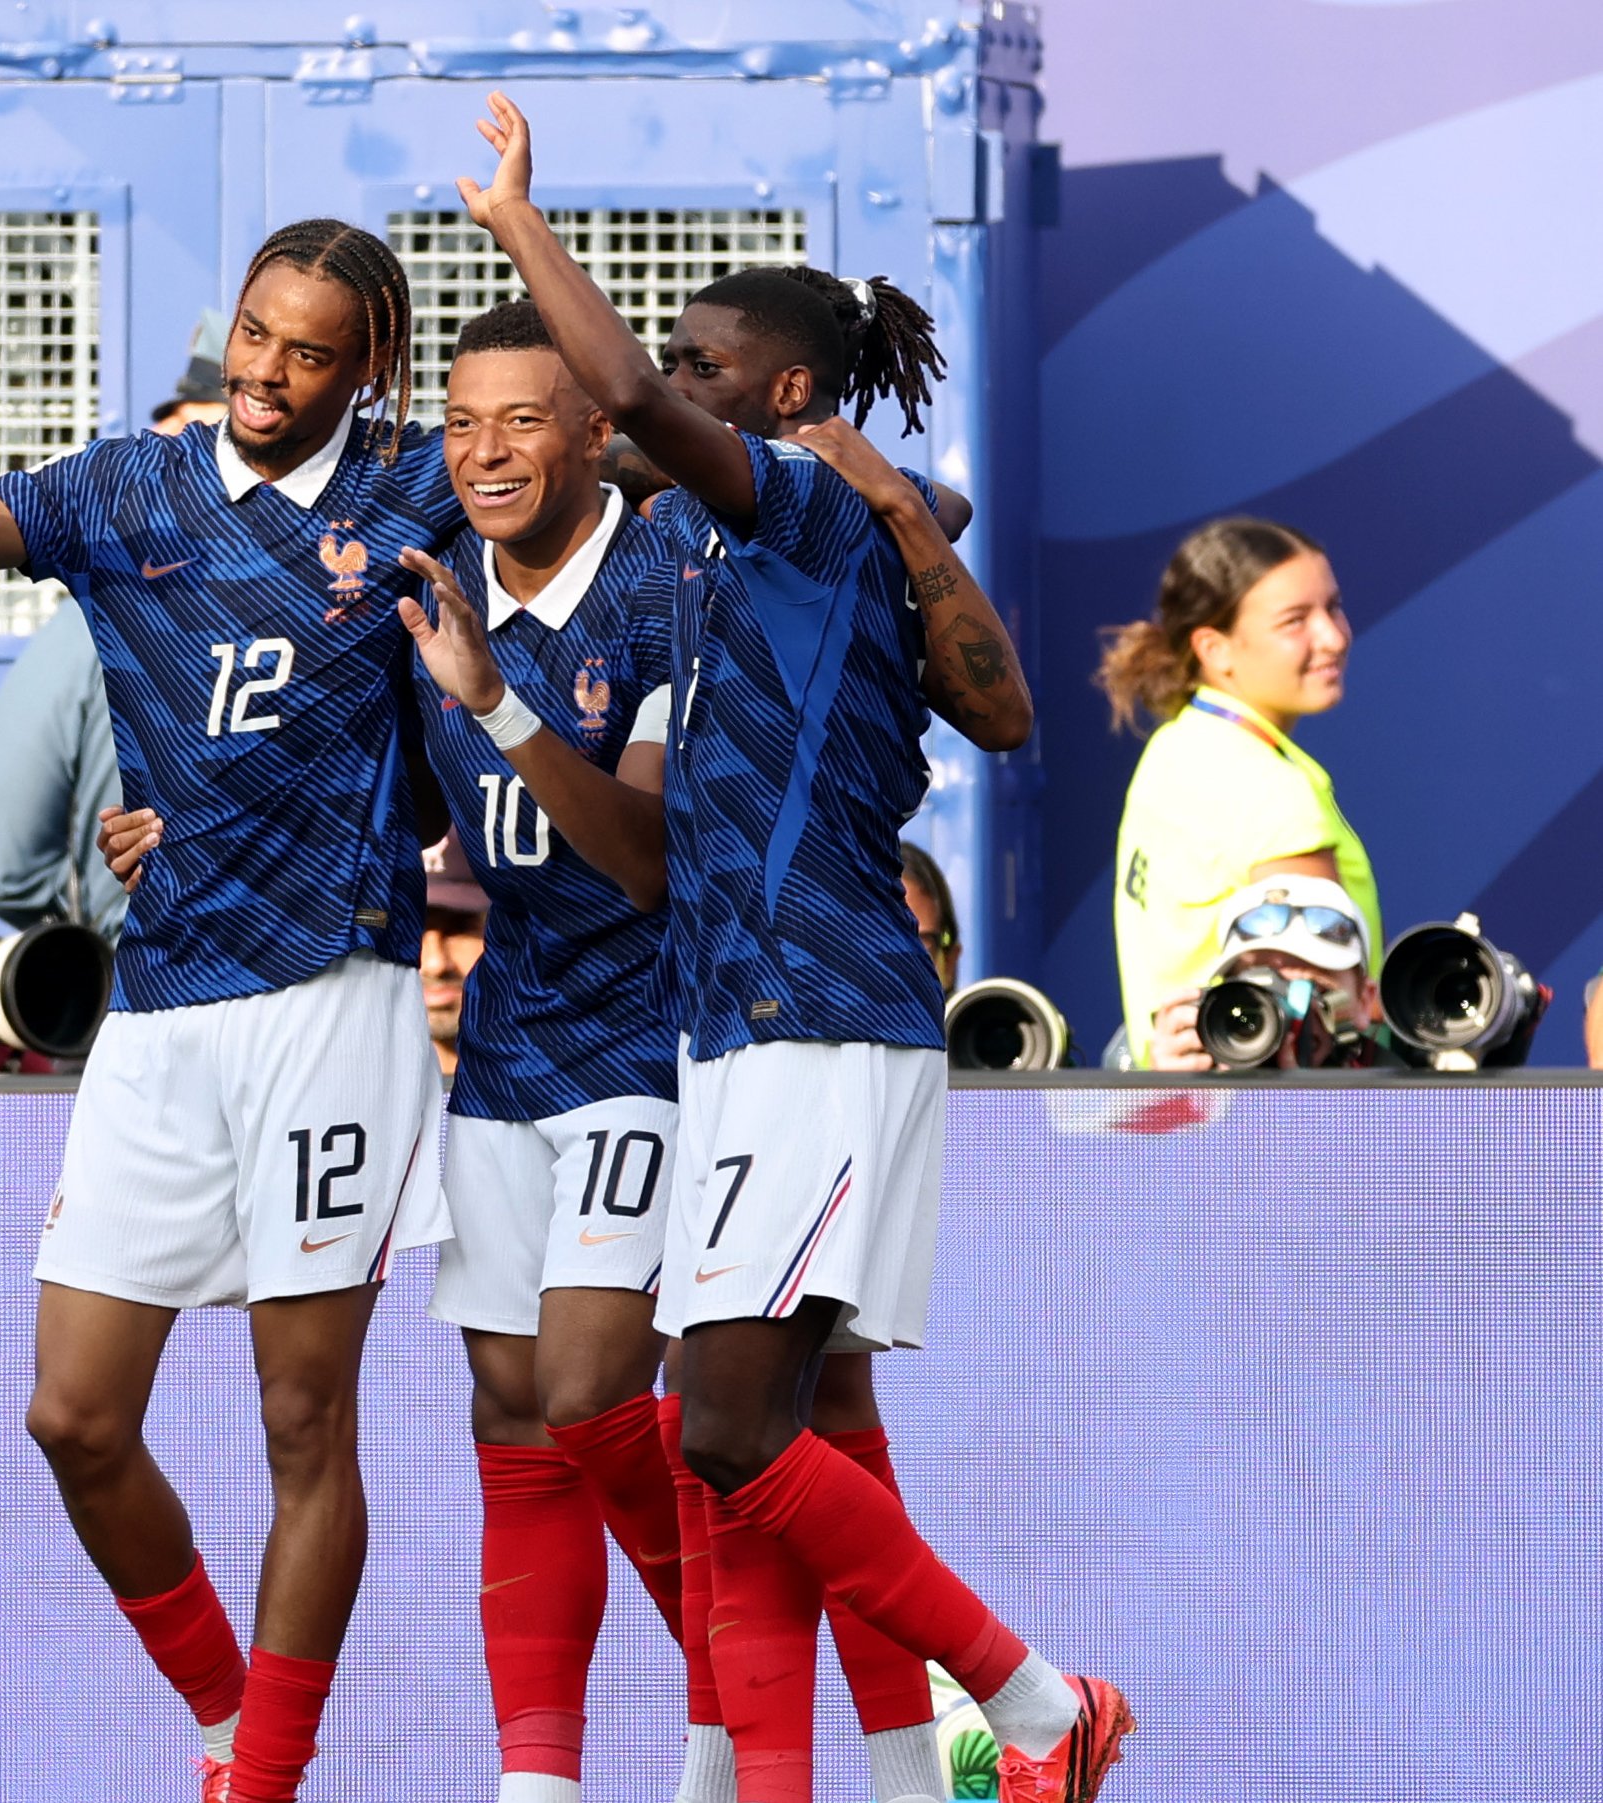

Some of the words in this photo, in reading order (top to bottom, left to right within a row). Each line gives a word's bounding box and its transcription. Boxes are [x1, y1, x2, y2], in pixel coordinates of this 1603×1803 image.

[207, 638, 294, 736] 12
[479, 774, 549, 868] 10
[288, 1122, 366, 1222] 12
[579, 1129, 665, 1218] 10
[706, 1154, 754, 1250] 7
